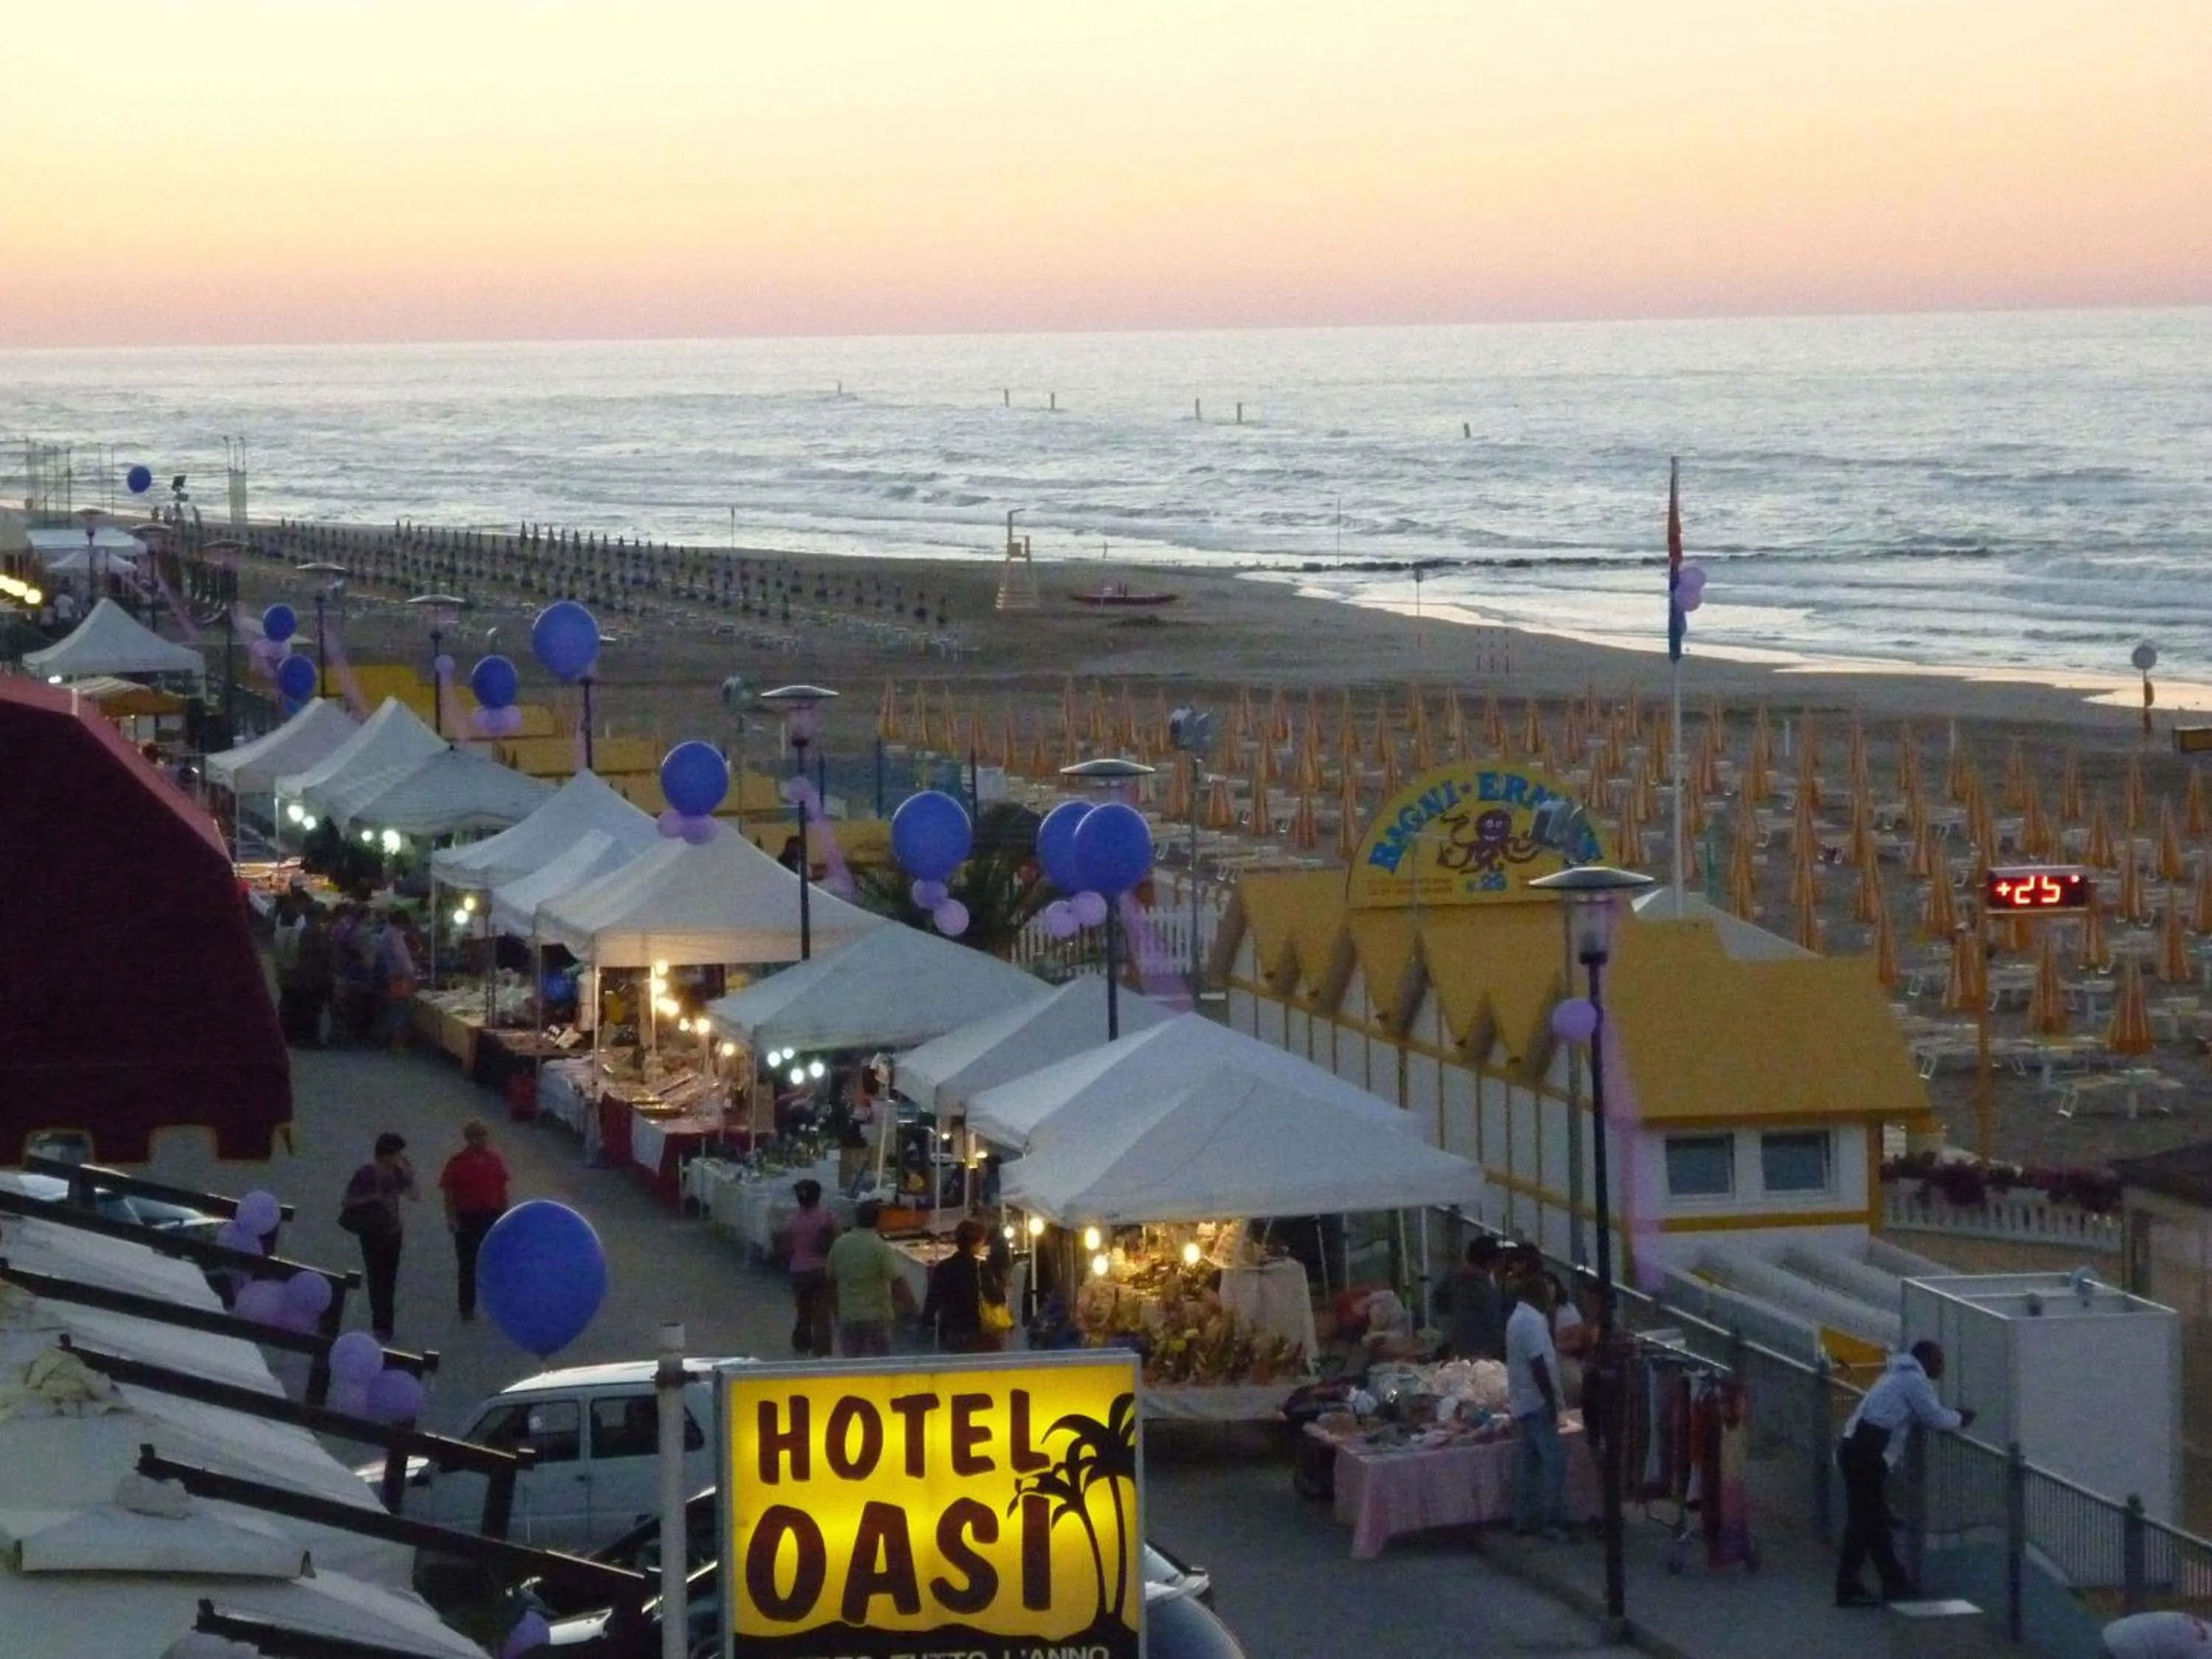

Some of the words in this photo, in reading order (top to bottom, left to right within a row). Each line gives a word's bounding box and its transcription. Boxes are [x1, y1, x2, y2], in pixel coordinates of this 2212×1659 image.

[1368, 780, 1461, 873] BAGNI
[757, 1389, 1050, 1484] HOTEL
[745, 1493, 1051, 1625] OASI
